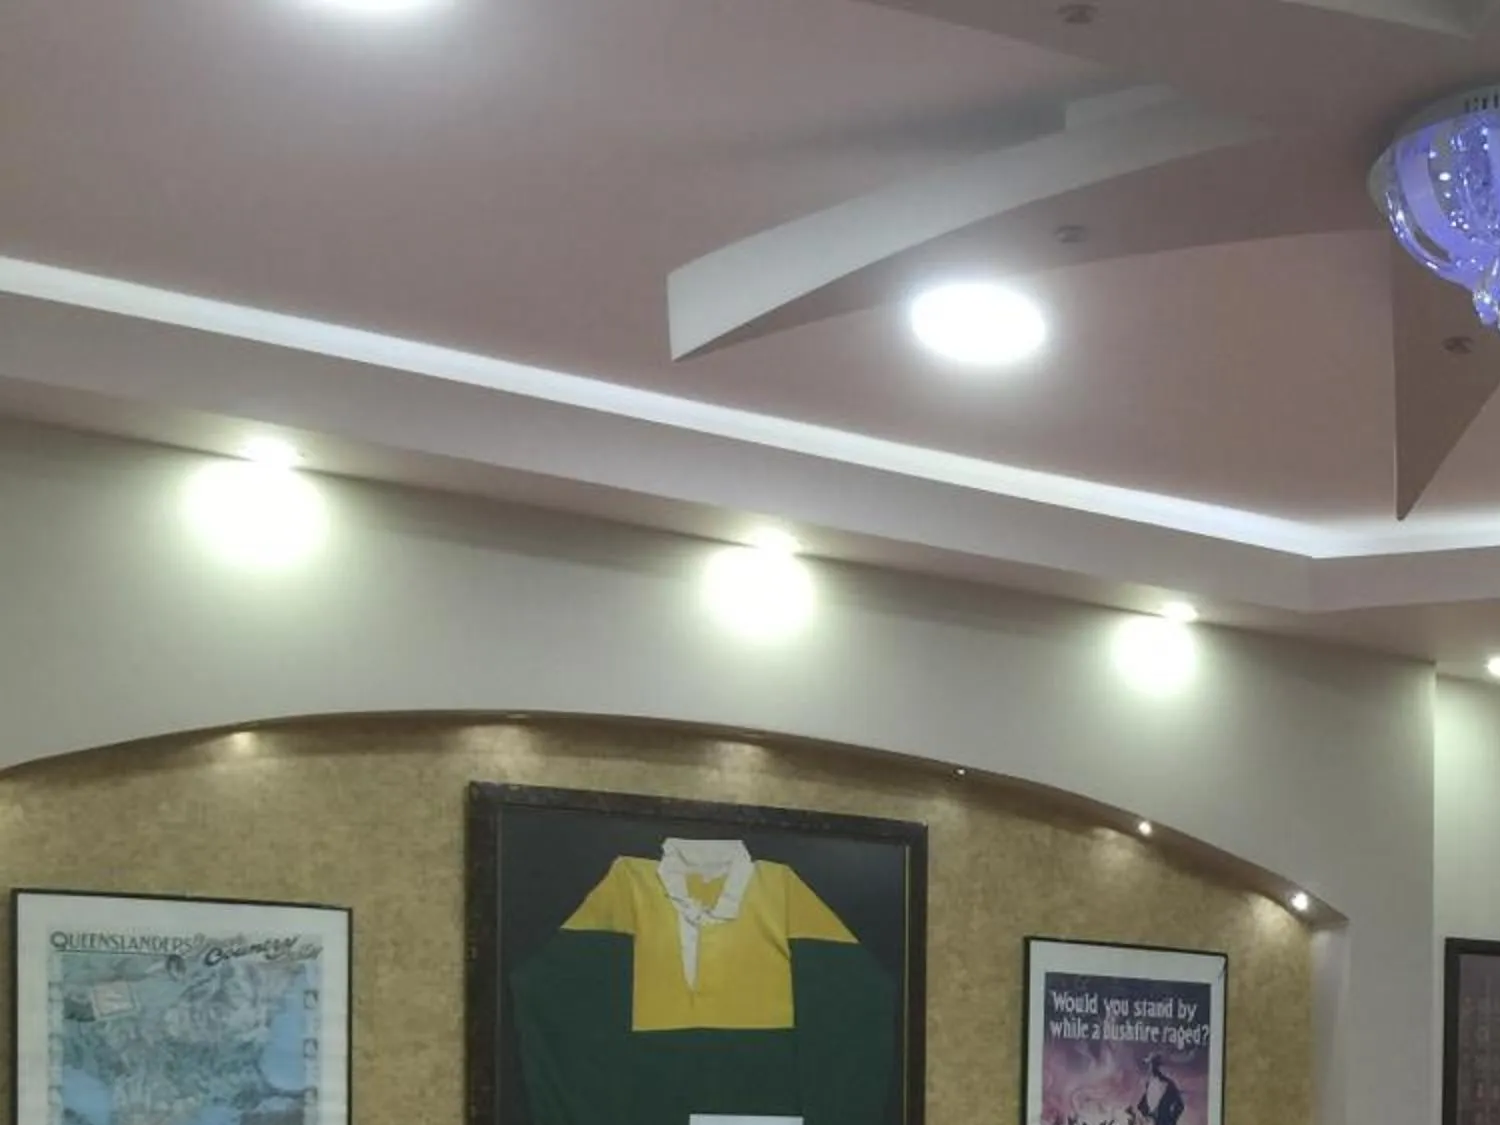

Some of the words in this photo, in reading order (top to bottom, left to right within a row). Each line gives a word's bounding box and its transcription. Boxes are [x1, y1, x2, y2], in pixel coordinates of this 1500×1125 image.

[1051, 991, 1099, 1014] Would
[1103, 998, 1129, 1020] you
[1133, 997, 1174, 1019] stand
[1177, 999, 1198, 1023] by
[1050, 1016, 1089, 1039] while
[1092, 1024, 1101, 1040] a
[1103, 1019, 1160, 1043] bushfire
[1161, 1023, 1210, 1050] raged?
